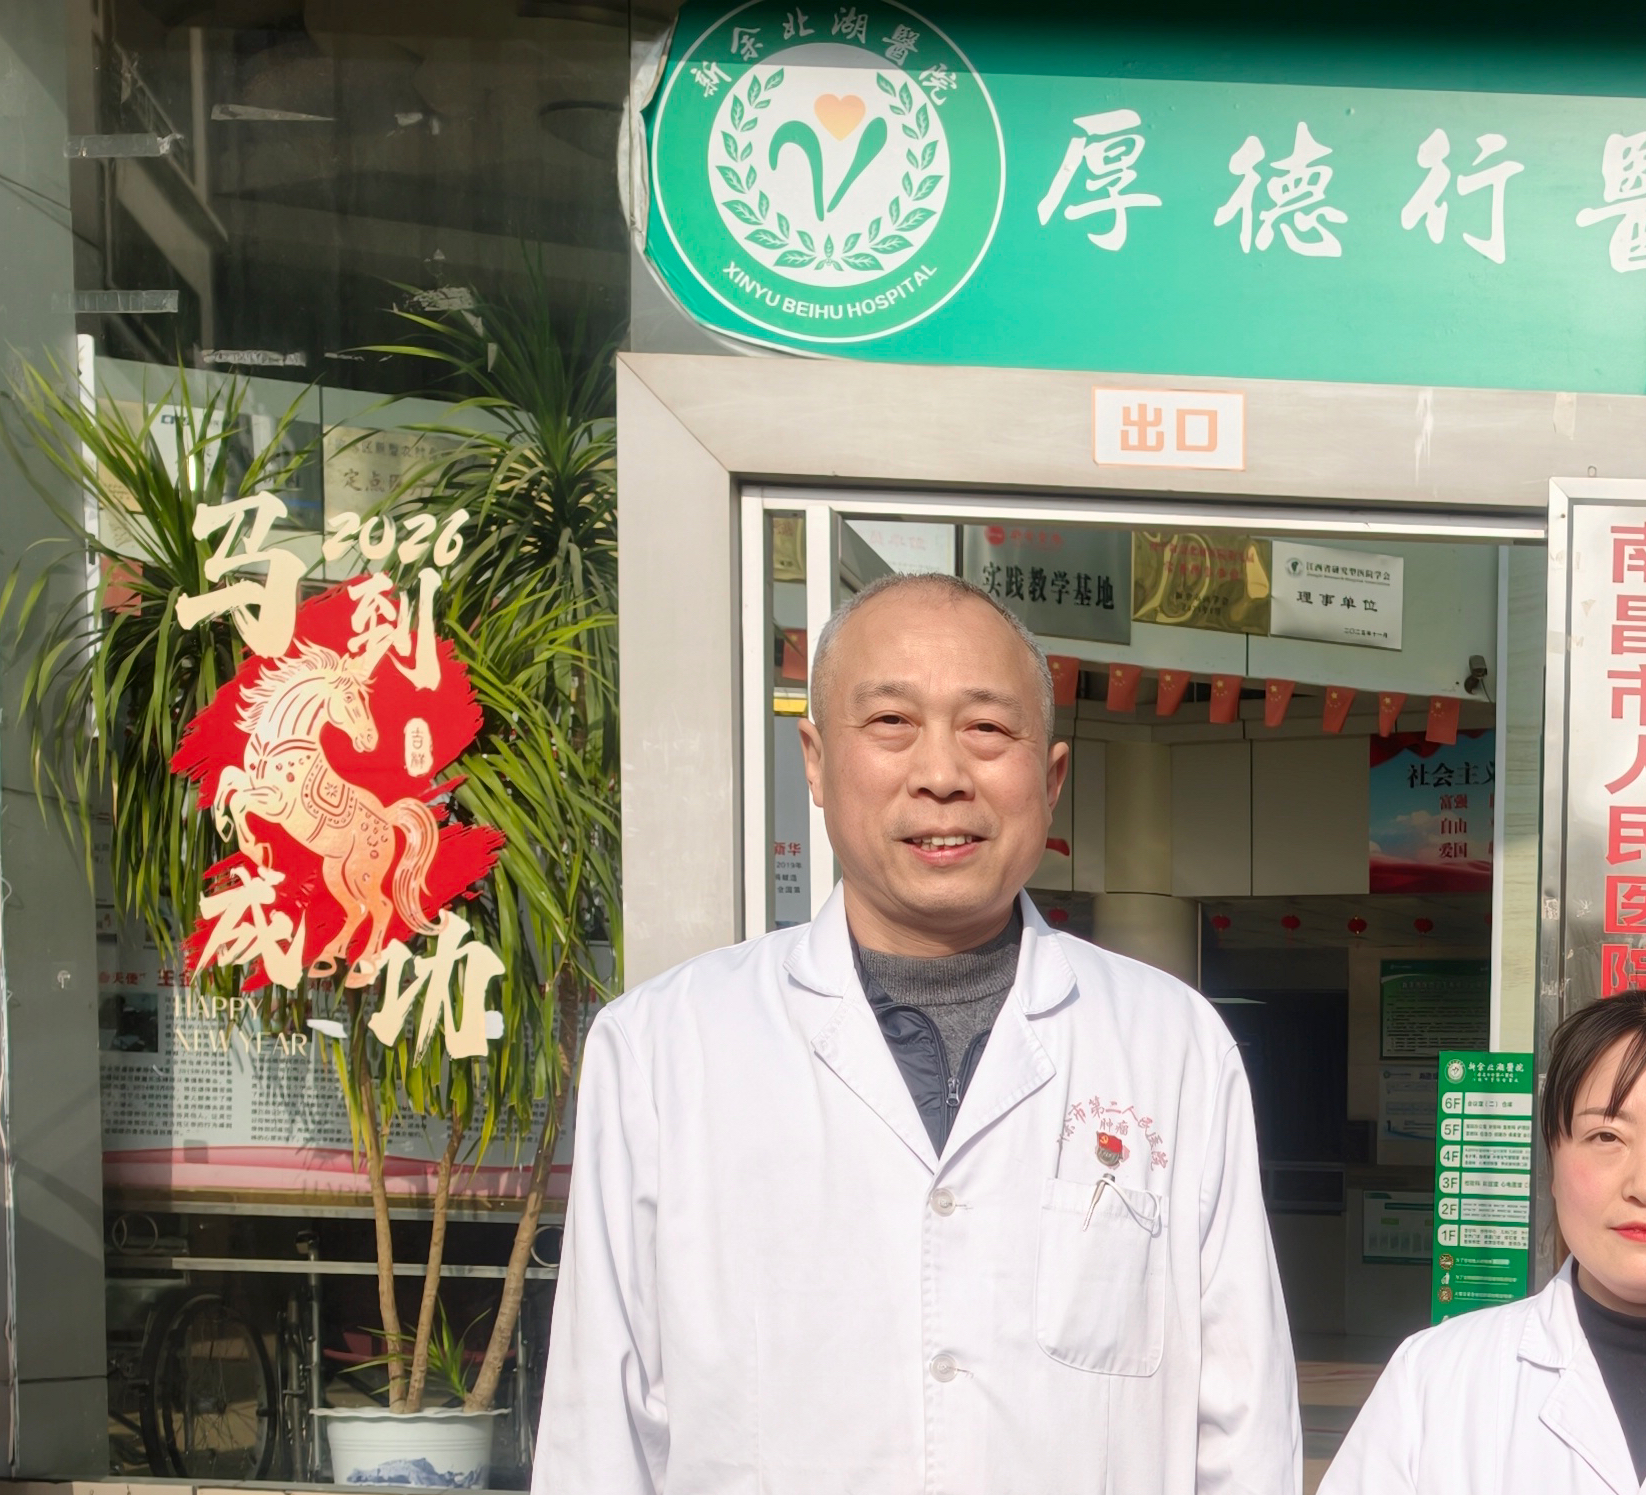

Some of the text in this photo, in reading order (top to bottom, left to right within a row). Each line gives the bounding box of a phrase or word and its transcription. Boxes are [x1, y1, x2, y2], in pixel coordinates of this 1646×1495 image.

[722, 261, 938, 320] XINYU BEIHU HOSPITAL
[1120, 403, 1219, 453] 出口
[322, 509, 470, 568] 2026
[982, 561, 1115, 610] 实践教学基地
[1296, 590, 1378, 612] 理事单位
[1440, 817, 1467, 834] 自由
[1439, 842, 1468, 858] 爱国
[174, 995, 263, 1020] HAPPY
[176, 1029, 308, 1057] NEW YEAR
[1445, 1098, 1461, 1109] 6F
[1100, 1118, 1129, 1136] 肿瘤
[1444, 1124, 1460, 1136] 5F
[1443, 1150, 1459, 1162] 4F
[1442, 1177, 1458, 1189] 3F
[1441, 1203, 1457, 1215] 2F
[1442, 1230, 1456, 1242] 1F
